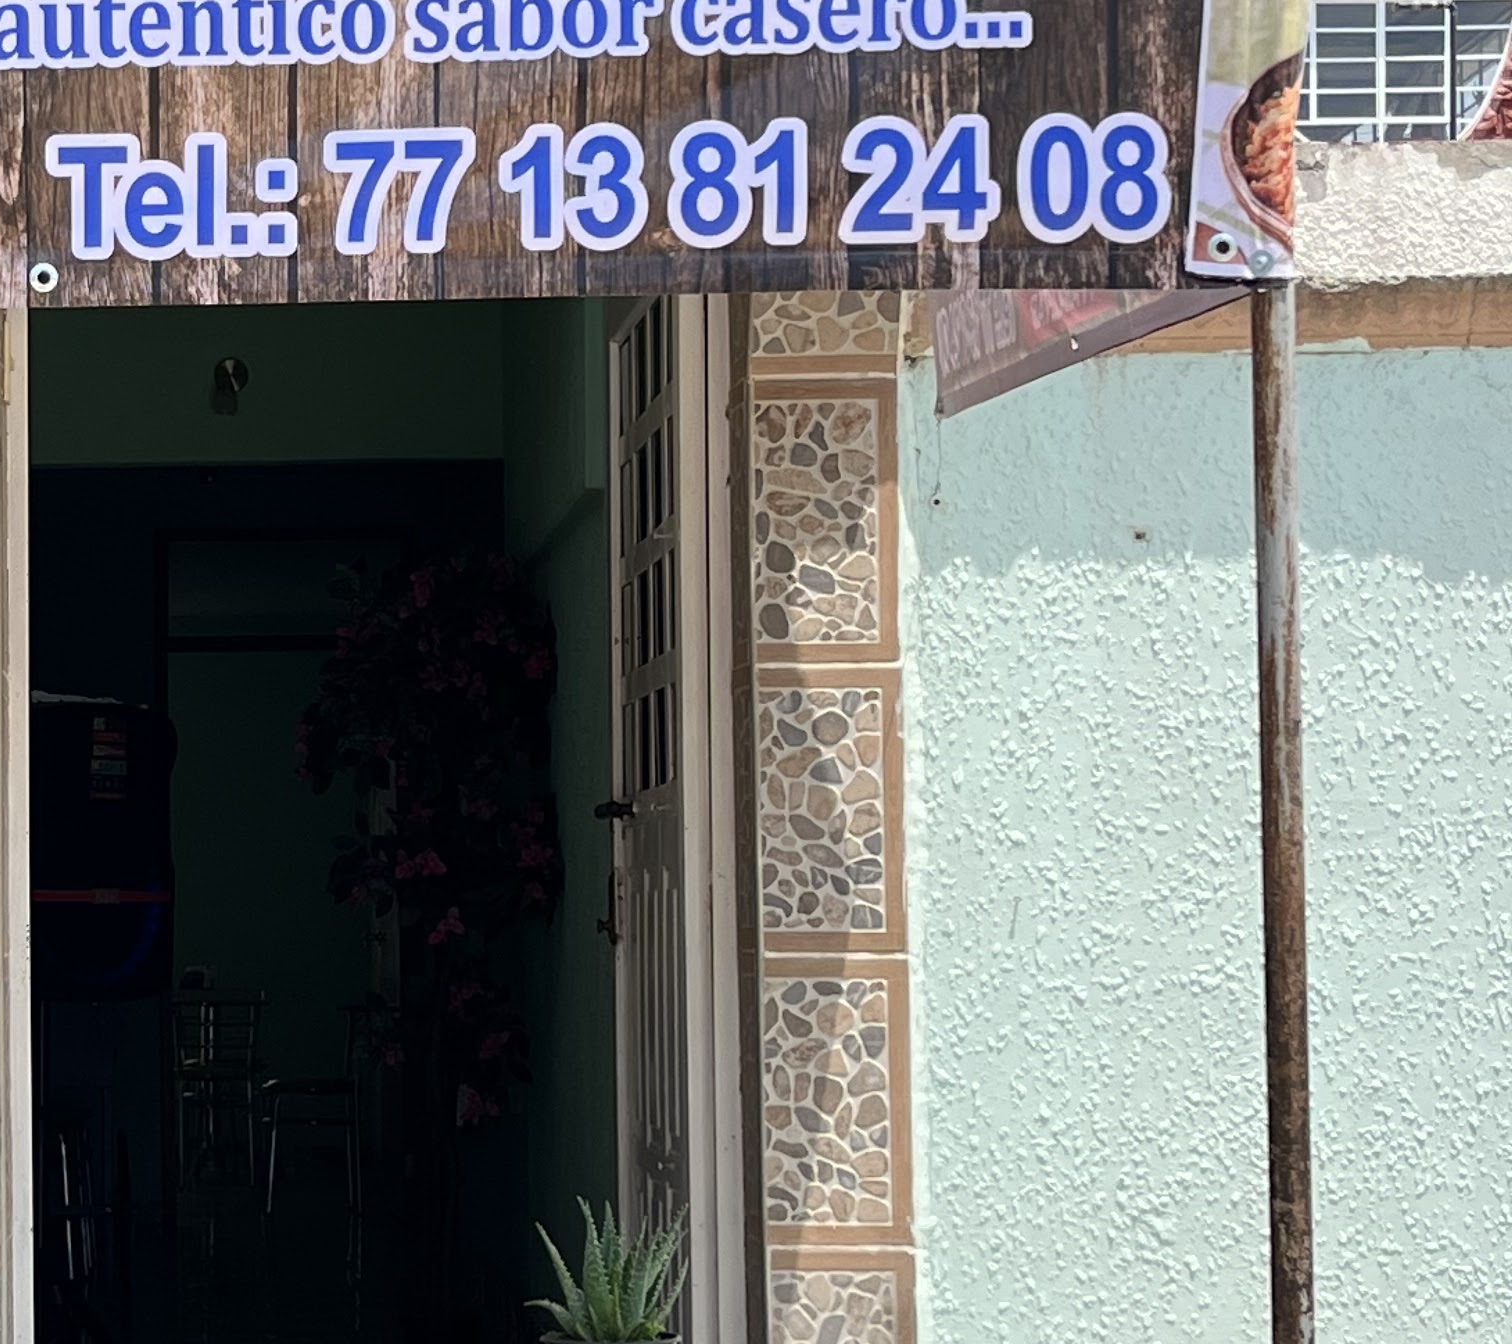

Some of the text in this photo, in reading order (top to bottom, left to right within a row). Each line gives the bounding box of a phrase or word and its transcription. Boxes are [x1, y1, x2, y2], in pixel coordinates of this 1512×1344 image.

[45, 111, 1174, 262] Tel.: 77 13 81 24 08
